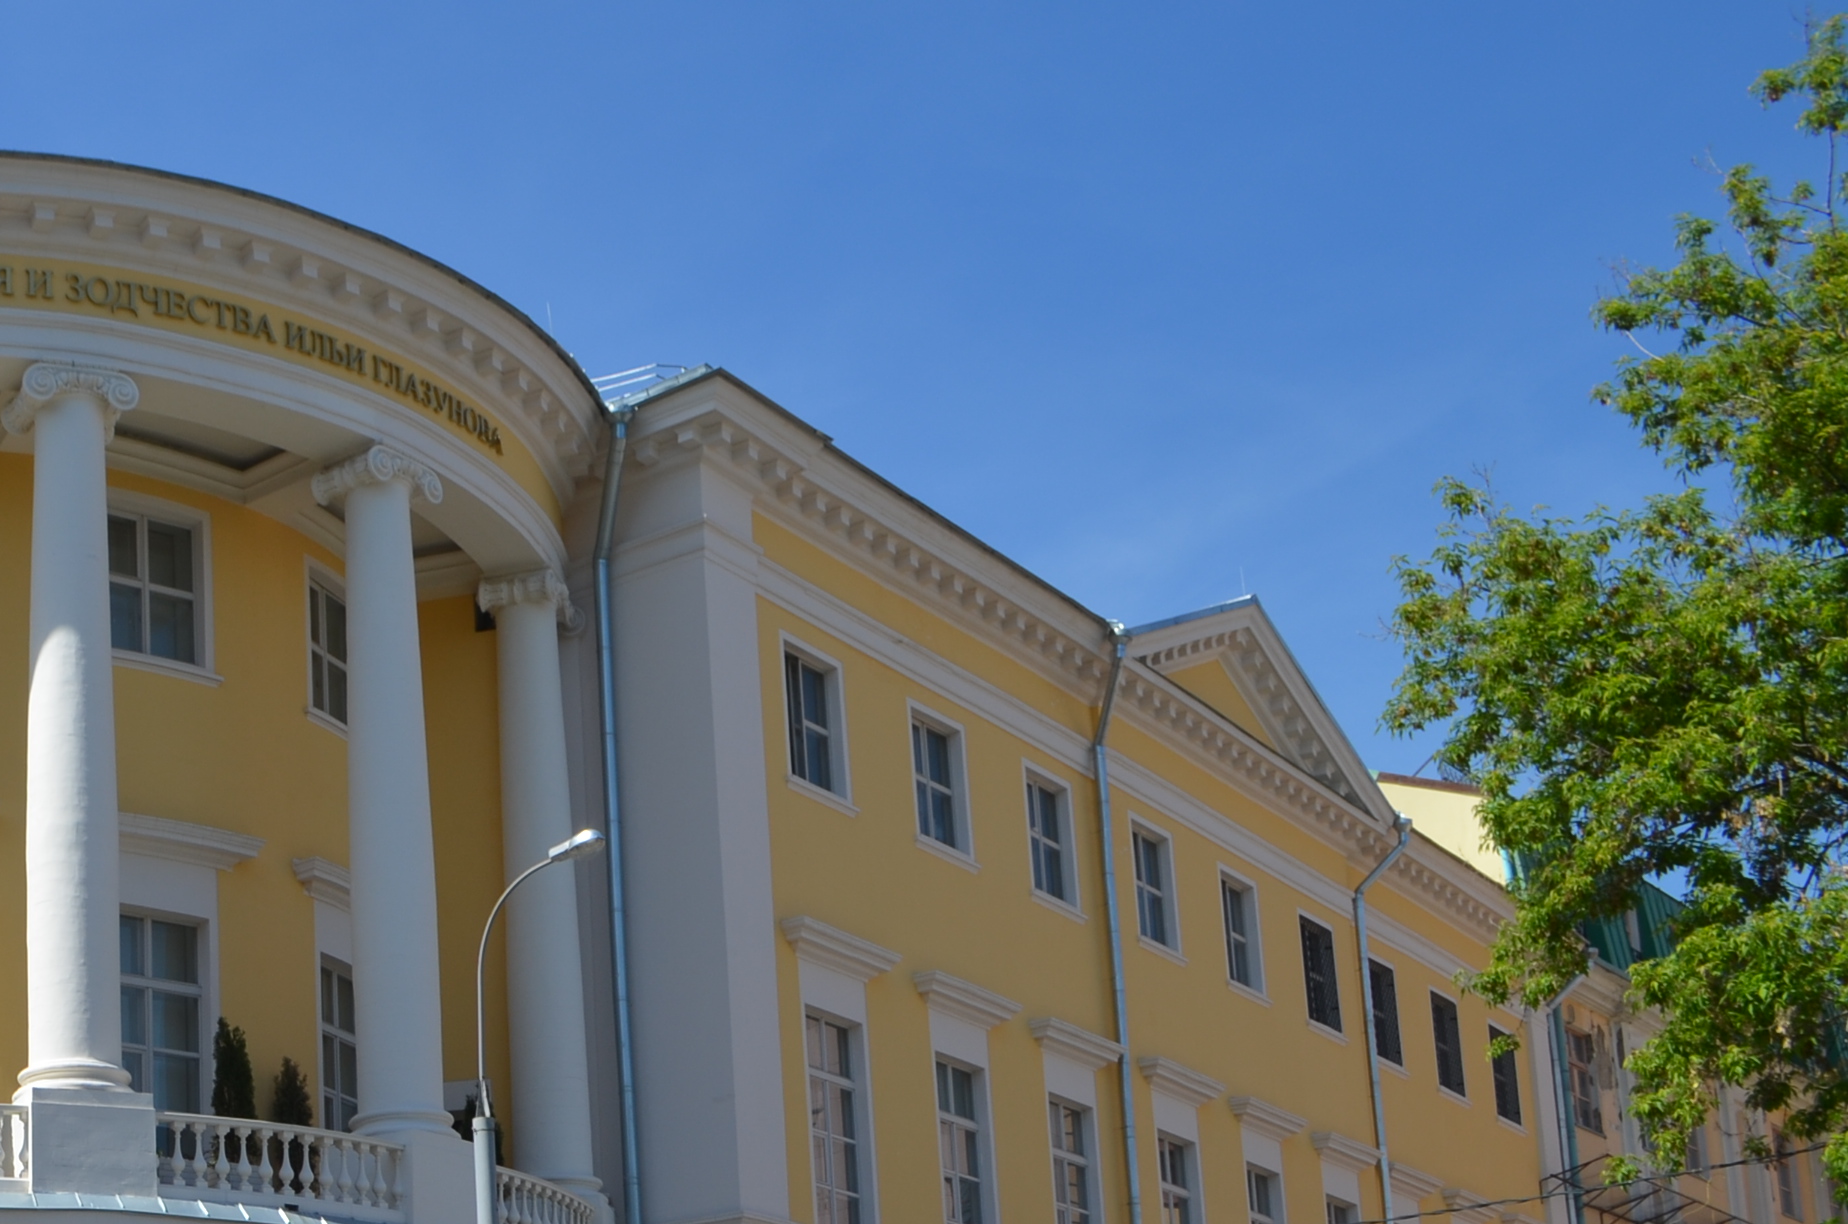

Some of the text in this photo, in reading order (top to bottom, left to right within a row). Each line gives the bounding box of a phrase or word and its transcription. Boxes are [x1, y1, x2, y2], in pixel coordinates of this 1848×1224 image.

[25, 267, 55, 300] И
[64, 271, 279, 346] ЗОДЧЕСТВА
[283, 320, 368, 376] ИЛЬИ
[371, 354, 504, 456] ГЛАЗУНОВА
